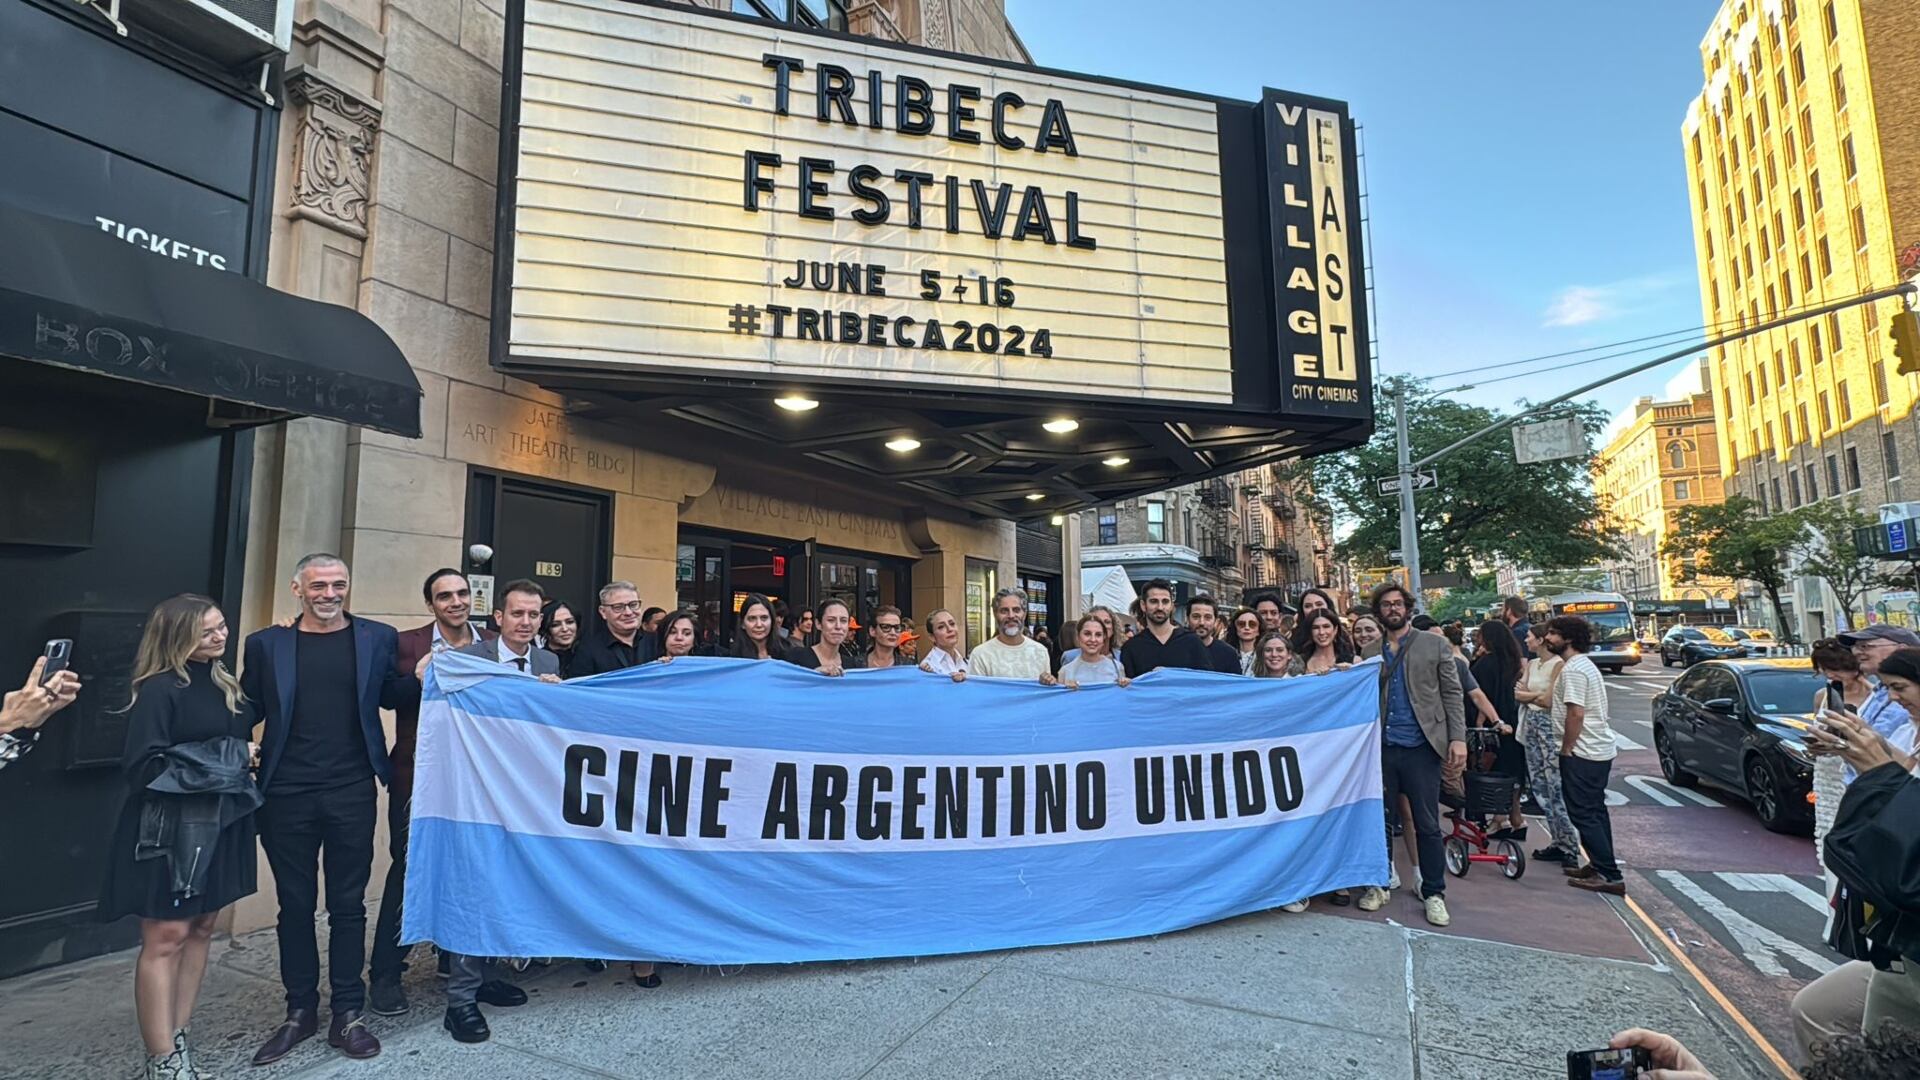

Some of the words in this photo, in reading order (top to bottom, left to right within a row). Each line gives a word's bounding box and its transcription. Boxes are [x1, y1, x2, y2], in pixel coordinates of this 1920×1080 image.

[762, 53, 1078, 157] TRIBECA
[743, 149, 1097, 250] FESTIVAL
[95, 216, 227, 271] TICKETS
[1275, 102, 1320, 379] VILLAGE
[783, 259, 887, 297] JUNE
[35, 312, 171, 374] BOX
[728, 303, 1054, 358] #TRIBECA2024
[1292, 384, 1313, 399] CITY
[1317, 386, 1358, 403] CINEMAS
[463, 423, 498, 446] ART
[509, 431, 579, 465] THEATRE
[587, 450, 625, 475] BLDG
[715, 485, 789, 520] VILLAGE
[798, 505, 831, 527] EAST
[838, 512, 897, 539] CINEMAS
[539, 564, 561, 576] 189
[563, 743, 732, 838] CINE
[761, 760, 1107, 841] ARGENTINO
[1134, 746, 1304, 825] UNIDO
